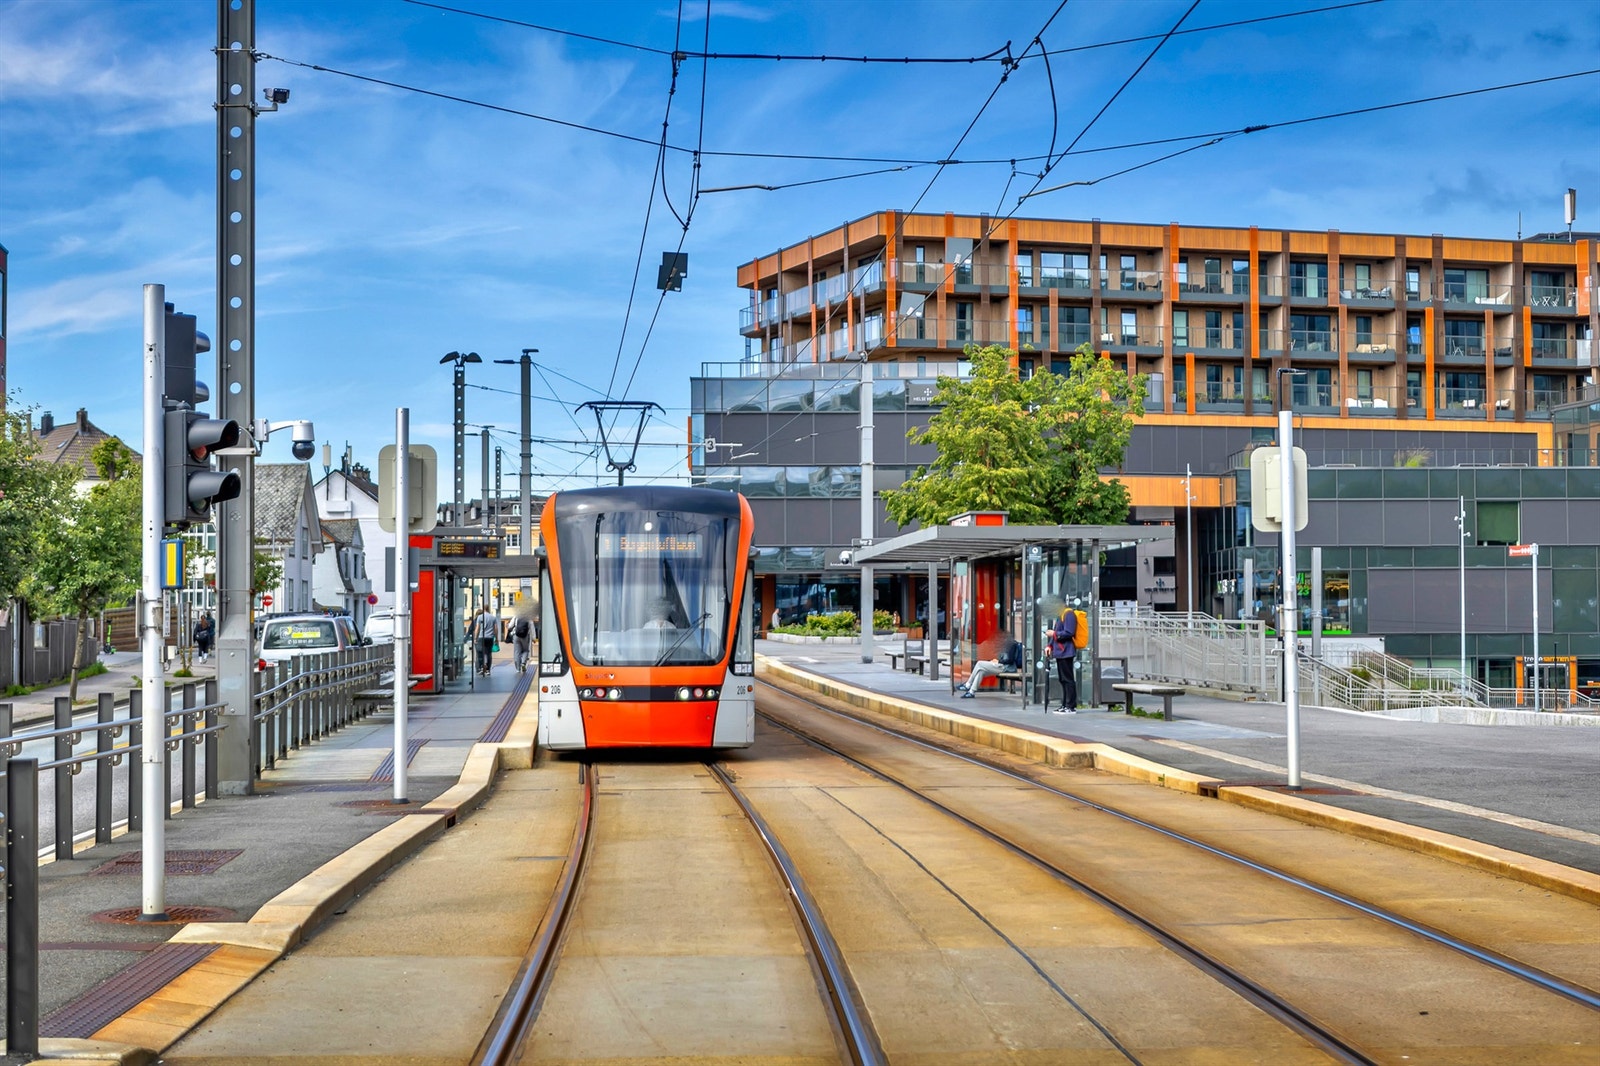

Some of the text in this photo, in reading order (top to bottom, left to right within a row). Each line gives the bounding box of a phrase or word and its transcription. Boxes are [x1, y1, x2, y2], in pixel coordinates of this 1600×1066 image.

[707, 440, 714, 450] 3
[481, 528, 492, 536] Spor
[551, 685, 561, 695] 206
[737, 685, 746, 695] 206
